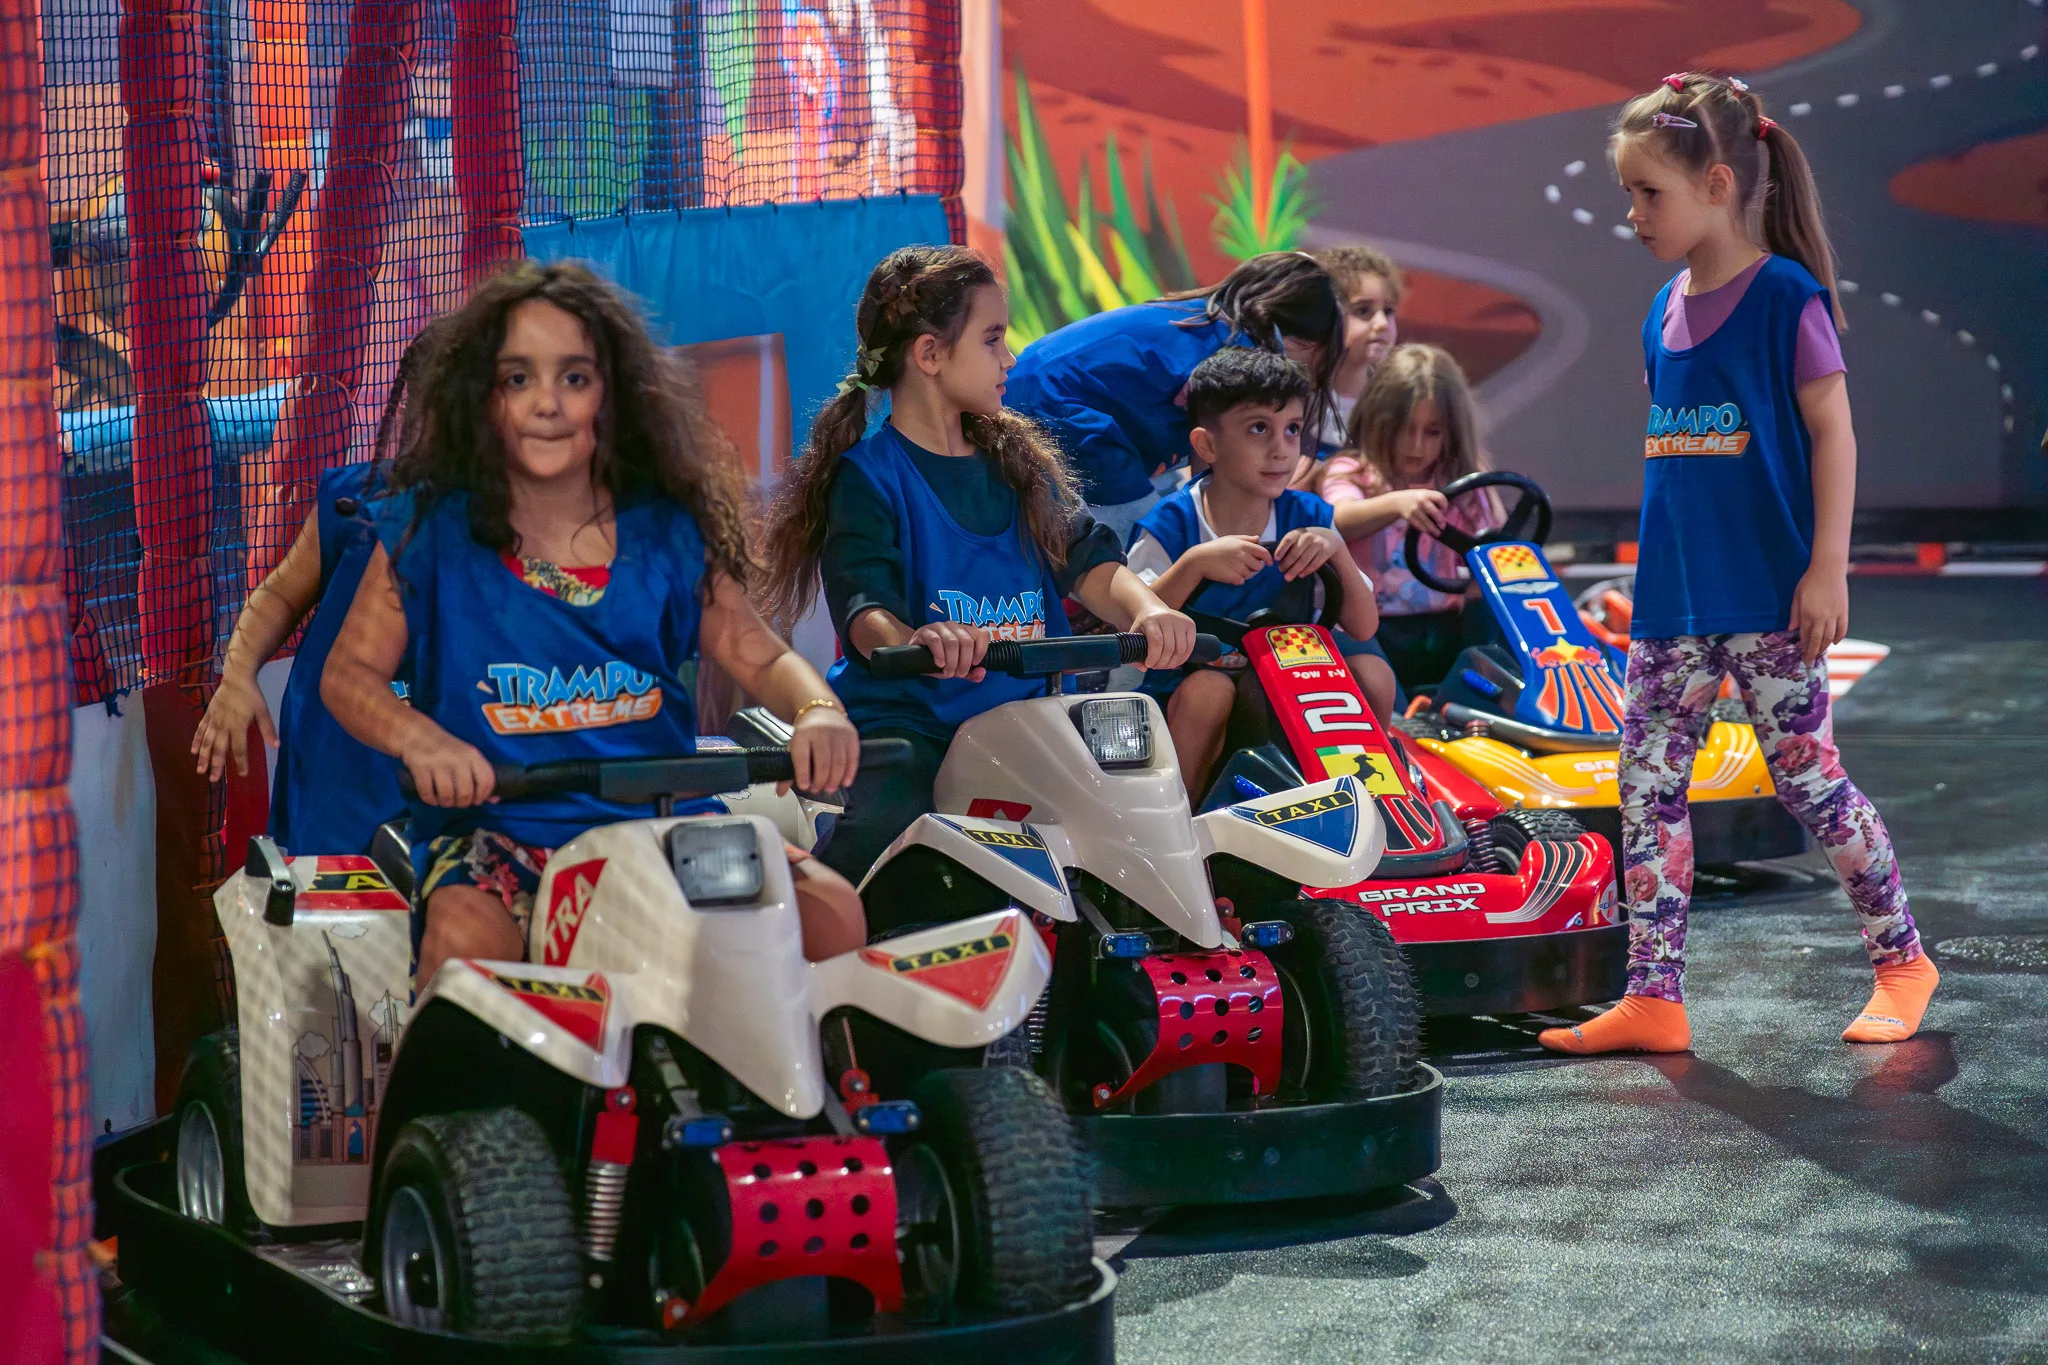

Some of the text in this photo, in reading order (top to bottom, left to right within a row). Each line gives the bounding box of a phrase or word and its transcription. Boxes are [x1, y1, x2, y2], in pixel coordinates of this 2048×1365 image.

[1647, 403, 1741, 438] RAMPO
[1645, 436, 1745, 454] EXTREME
[1522, 598, 1567, 635] 1
[494, 696, 656, 729] EXTREME
[1296, 691, 1375, 733] 2
[1267, 796, 1340, 821] TAXI
[973, 831, 1034, 846] TAXI
[1358, 883, 1486, 902] GRAND
[1381, 897, 1481, 917] PRIX
[906, 938, 994, 969] TAXI
[510, 978, 592, 1000] TAXI
